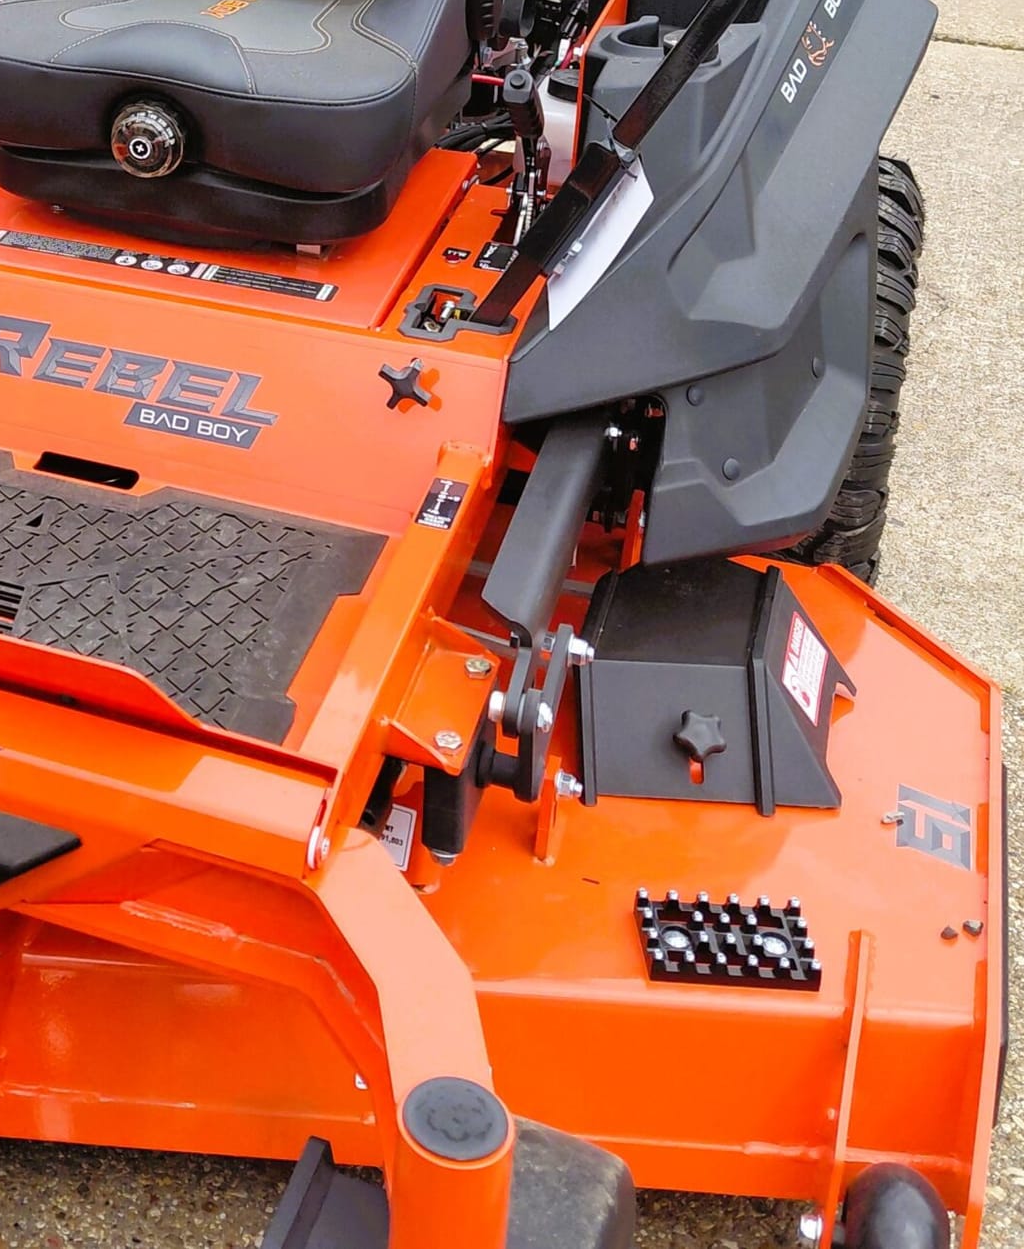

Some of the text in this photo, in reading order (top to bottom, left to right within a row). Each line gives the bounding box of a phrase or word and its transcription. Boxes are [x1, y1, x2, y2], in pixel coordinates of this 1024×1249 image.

[780, 58, 808, 103] BAD
[139, 407, 250, 443] BAD BOY
